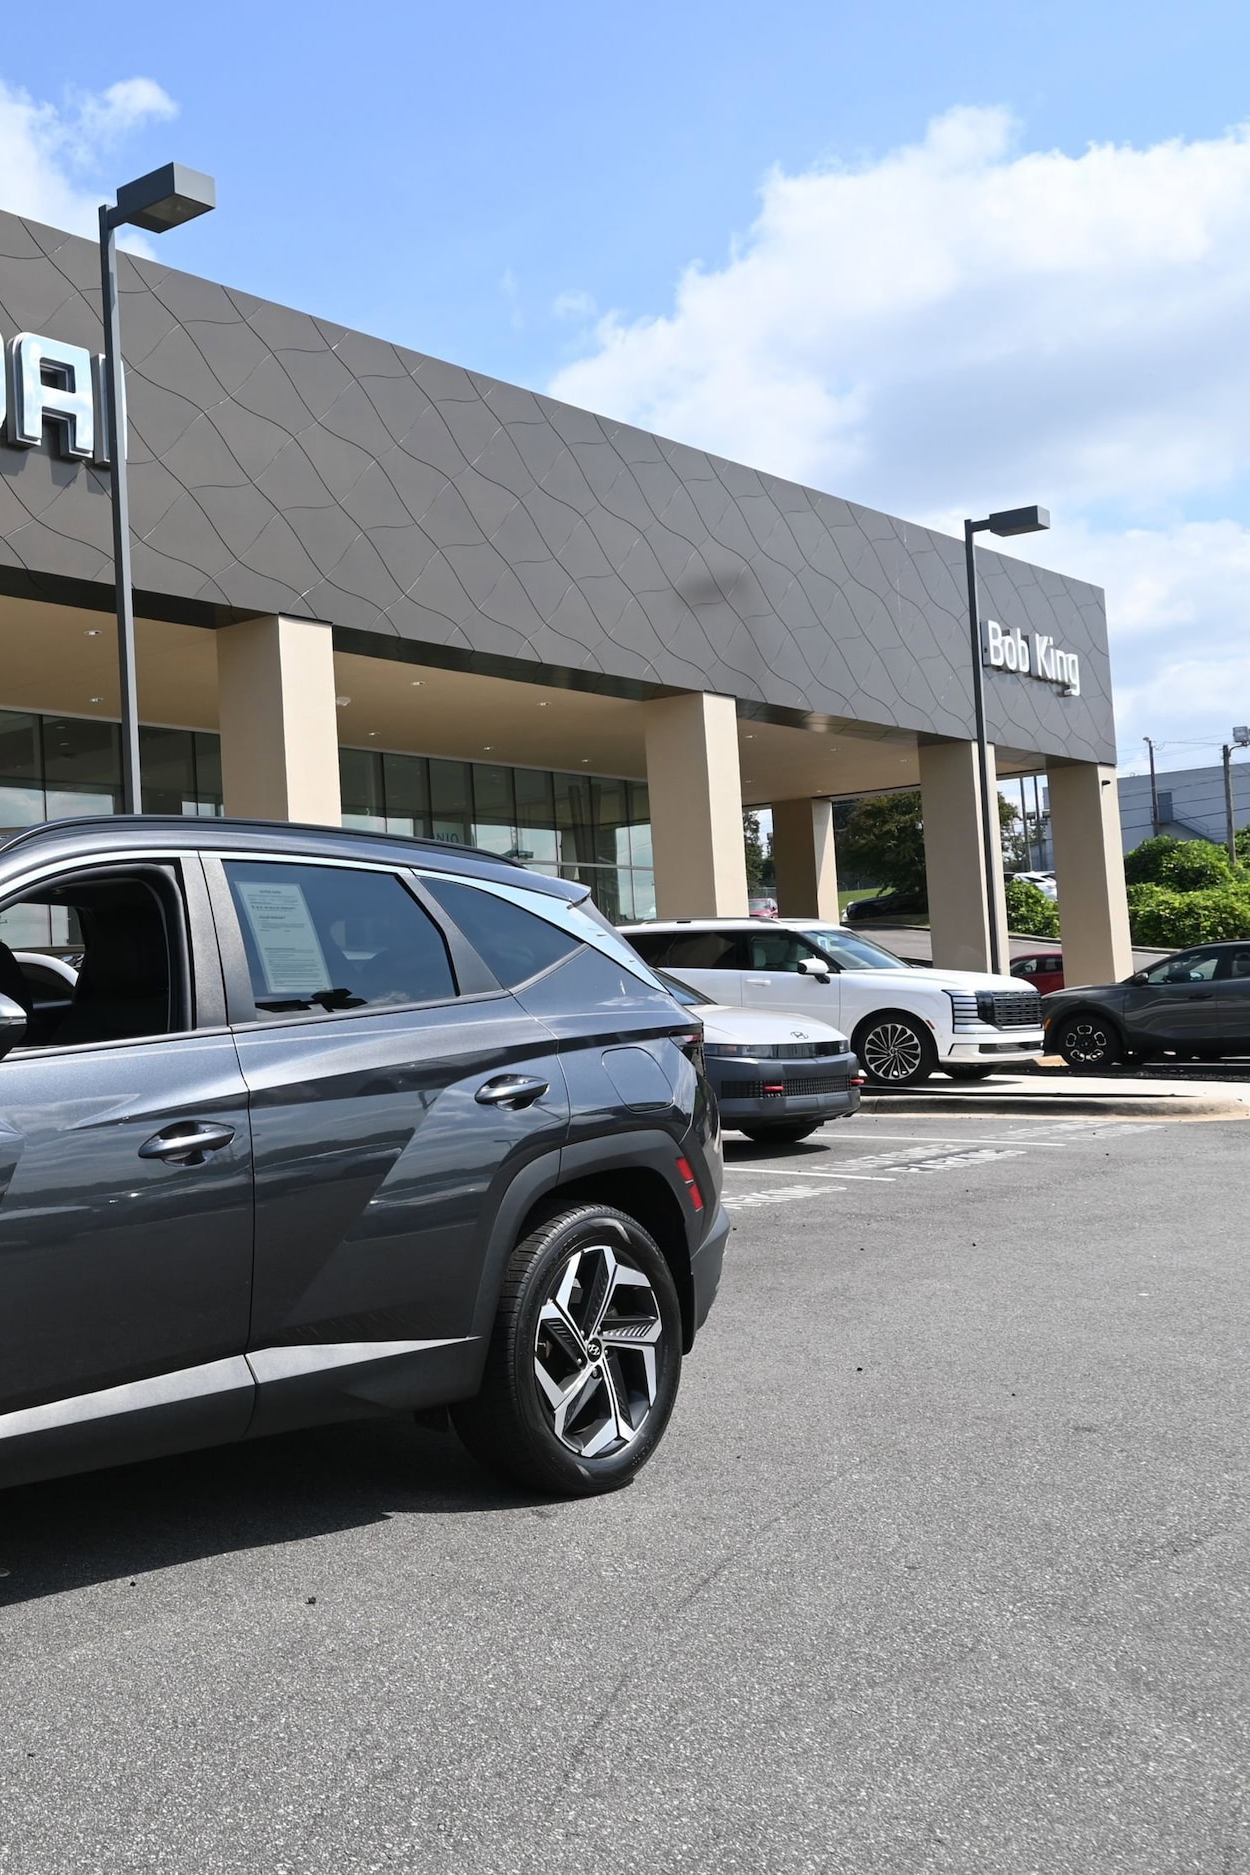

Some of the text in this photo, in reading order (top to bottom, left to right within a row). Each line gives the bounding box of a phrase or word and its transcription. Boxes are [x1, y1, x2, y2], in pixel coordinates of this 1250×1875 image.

[984, 619, 1081, 697] Bob King
[721, 1184, 848, 1209] ARKING
